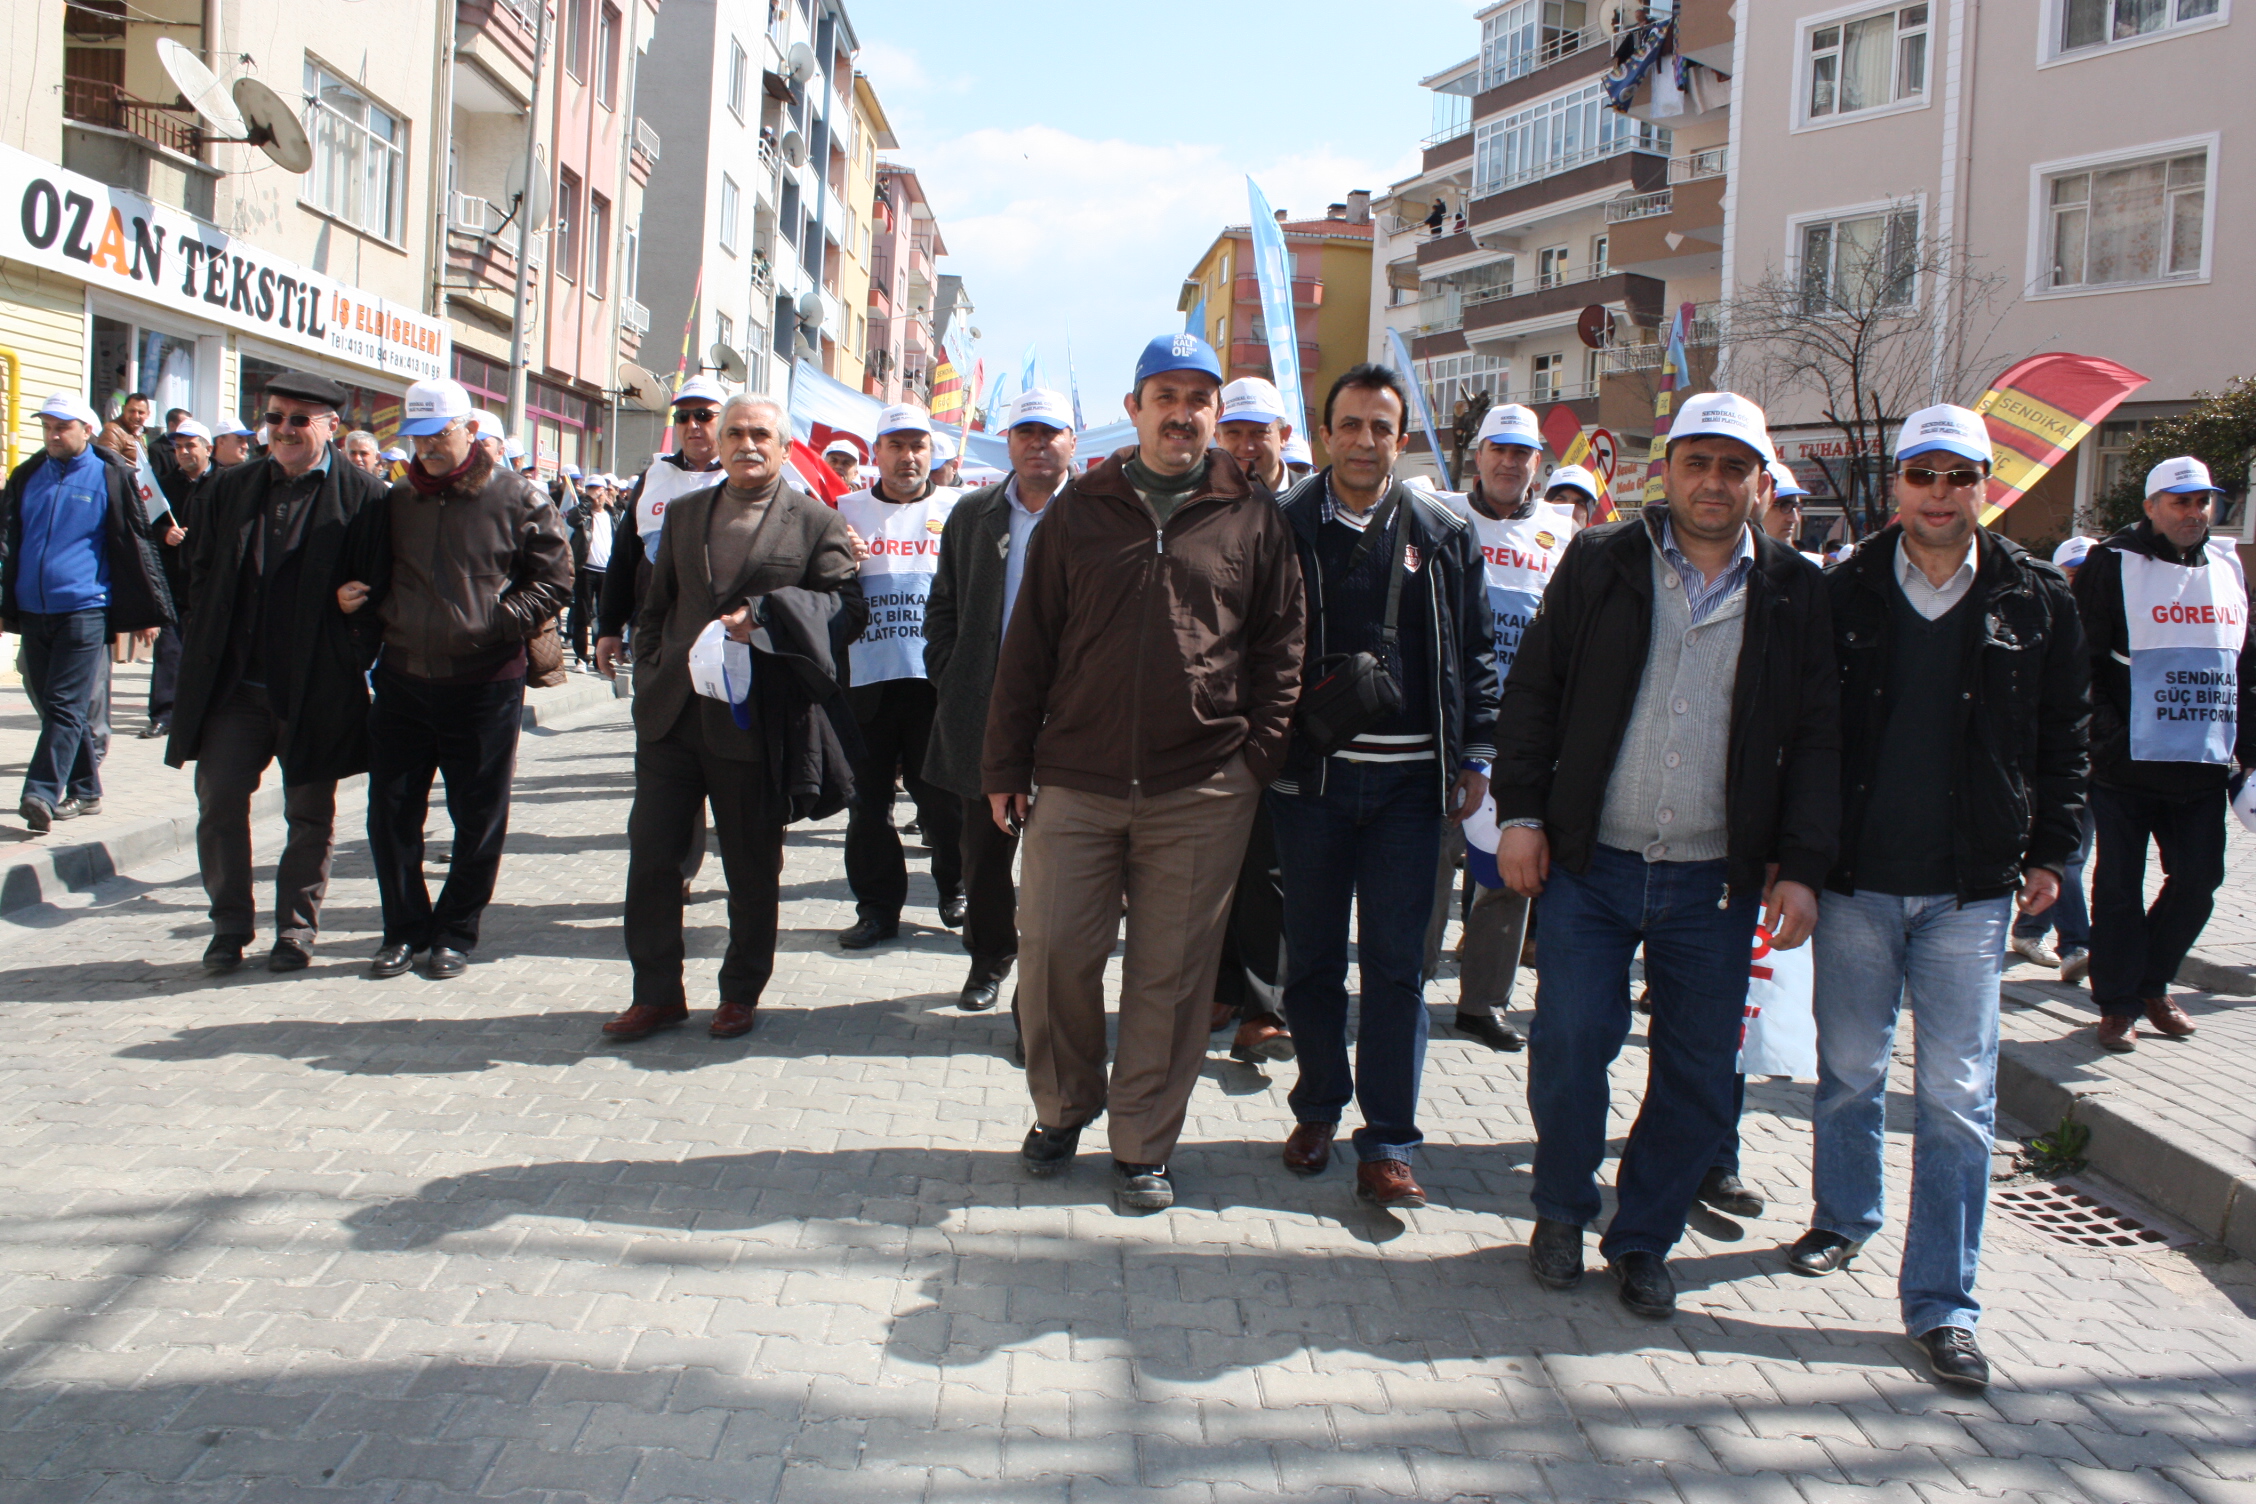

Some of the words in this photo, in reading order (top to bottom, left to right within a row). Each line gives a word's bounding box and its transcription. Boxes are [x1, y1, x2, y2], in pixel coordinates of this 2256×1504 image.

[21, 178, 166, 286] OZAN
[1993, 451, 2011, 470] ÜÇ
[863, 537, 941, 556] ÖREVL
[1481, 545, 1549, 574] REVLİ
[862, 591, 930, 609] SENDİKA
[2152, 602, 2239, 625] GÖREVLİ
[2165, 669, 2237, 686] SENDİKAL
[2154, 687, 2192, 707] GÜÇ
[2196, 687, 2238, 706] BİRLİĞ
